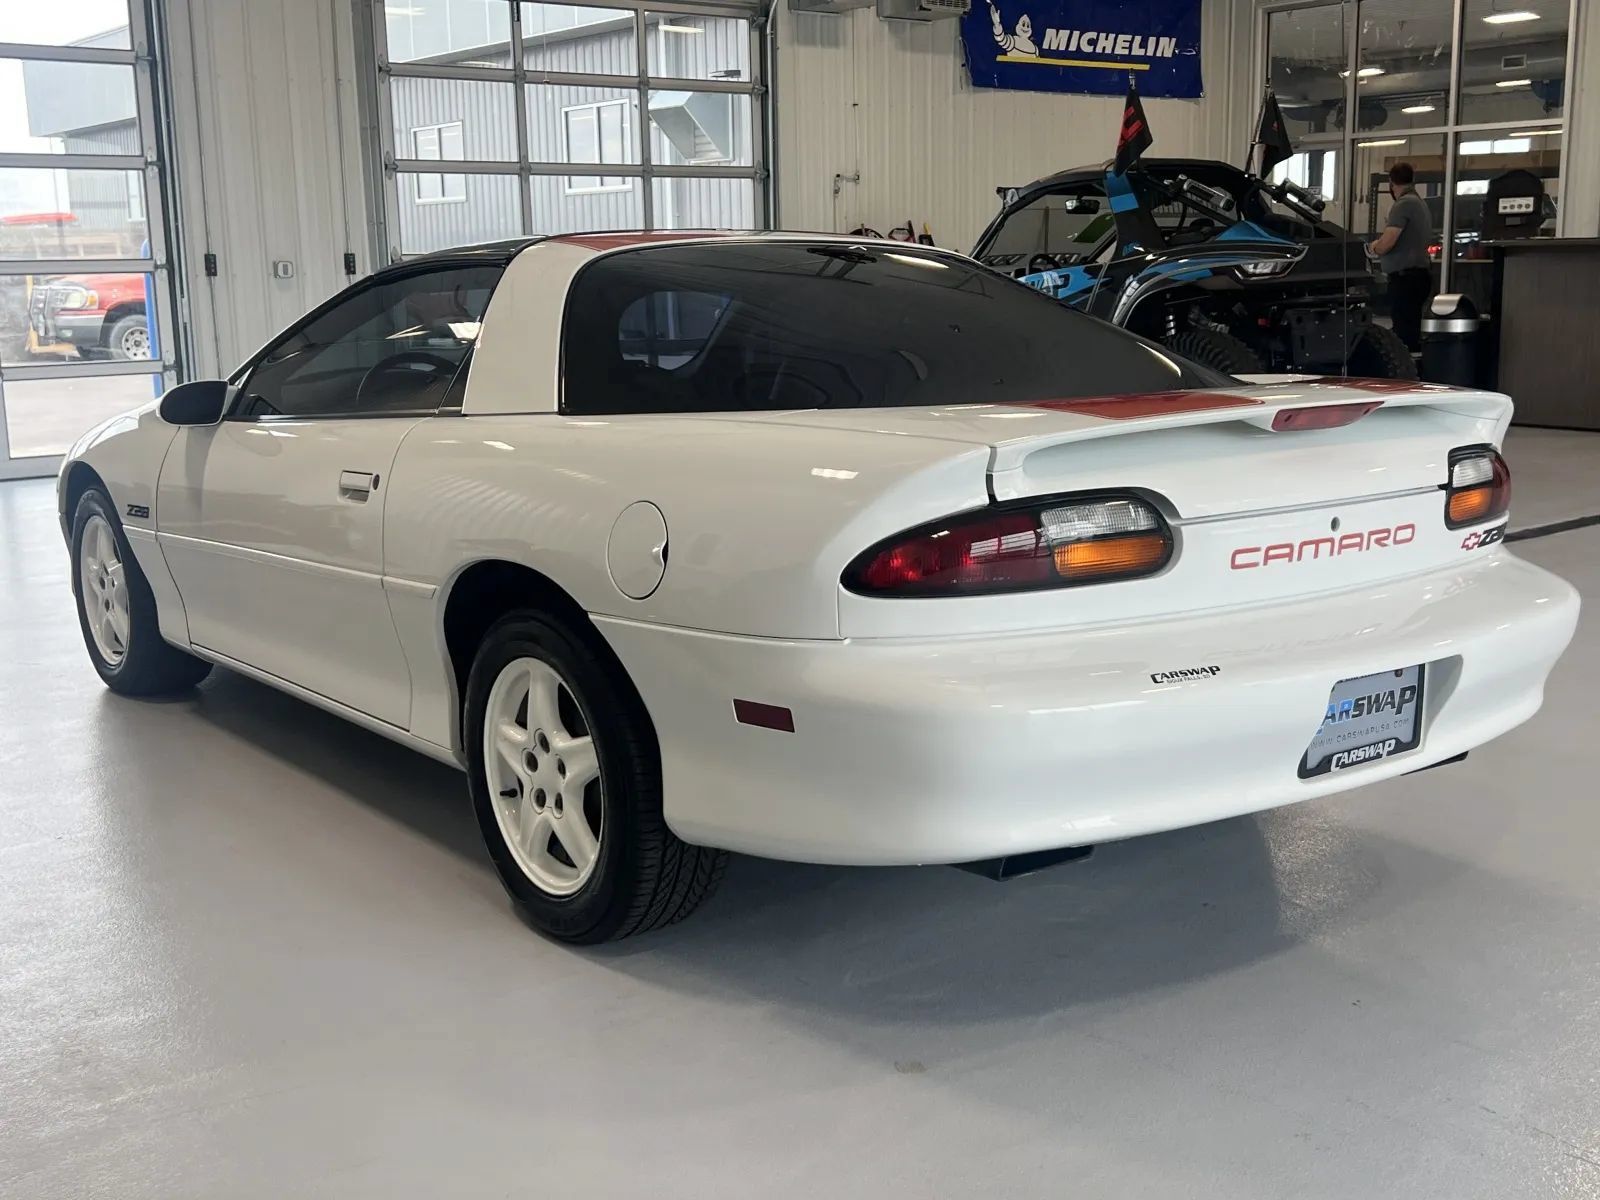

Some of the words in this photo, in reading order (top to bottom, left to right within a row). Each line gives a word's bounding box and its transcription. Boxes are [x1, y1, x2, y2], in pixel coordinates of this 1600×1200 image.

[1042, 28, 1177, 58] MICHELIN
[1230, 523, 1416, 570] CAMARO
[1150, 665, 1221, 684] CARSWAP
[1316, 685, 1417, 735] ARSWAP
[1330, 738, 1396, 773] CARSWAP
